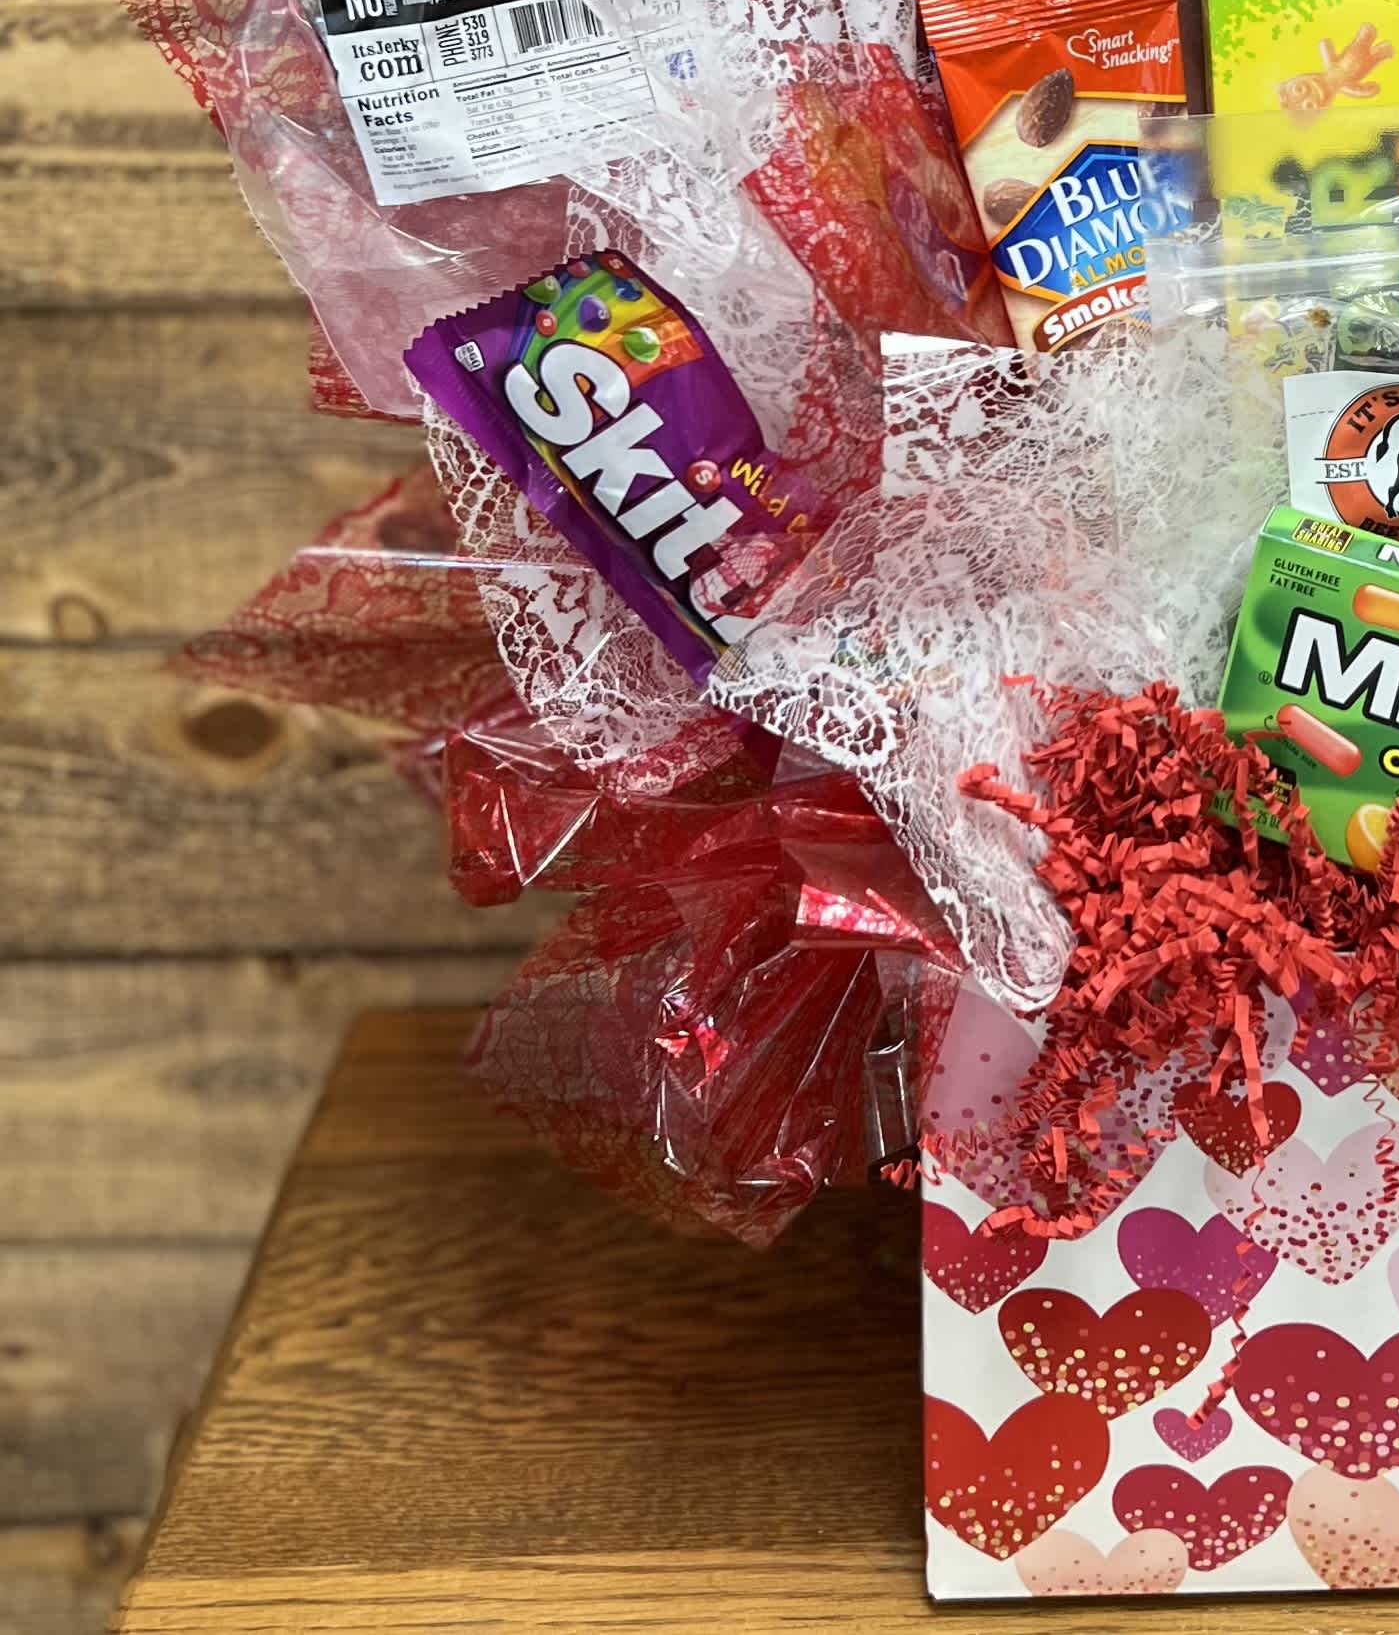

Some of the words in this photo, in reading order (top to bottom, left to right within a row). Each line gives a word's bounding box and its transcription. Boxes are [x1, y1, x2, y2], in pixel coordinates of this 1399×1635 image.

[462, 14, 487, 31] 530
[351, 37, 420, 59] ItsJerky
[436, 19, 468, 67] PHONE
[467, 30, 490, 46] 319
[1088, 30, 1135, 53] Smart
[470, 45, 494, 61] 3773
[1101, 40, 1172, 70] Snacking!
[357, 88, 440, 111] Nutrition
[363, 111, 414, 127] Facts
[1324, 462, 1368, 480] EST.
[1296, 530, 1343, 552] SHARING
[1274, 558, 1314, 578] GLUTEN
[1315, 571, 1341, 587] FREE
[1270, 574, 1289, 588] FAT
[1291, 580, 1315, 597] FREE
